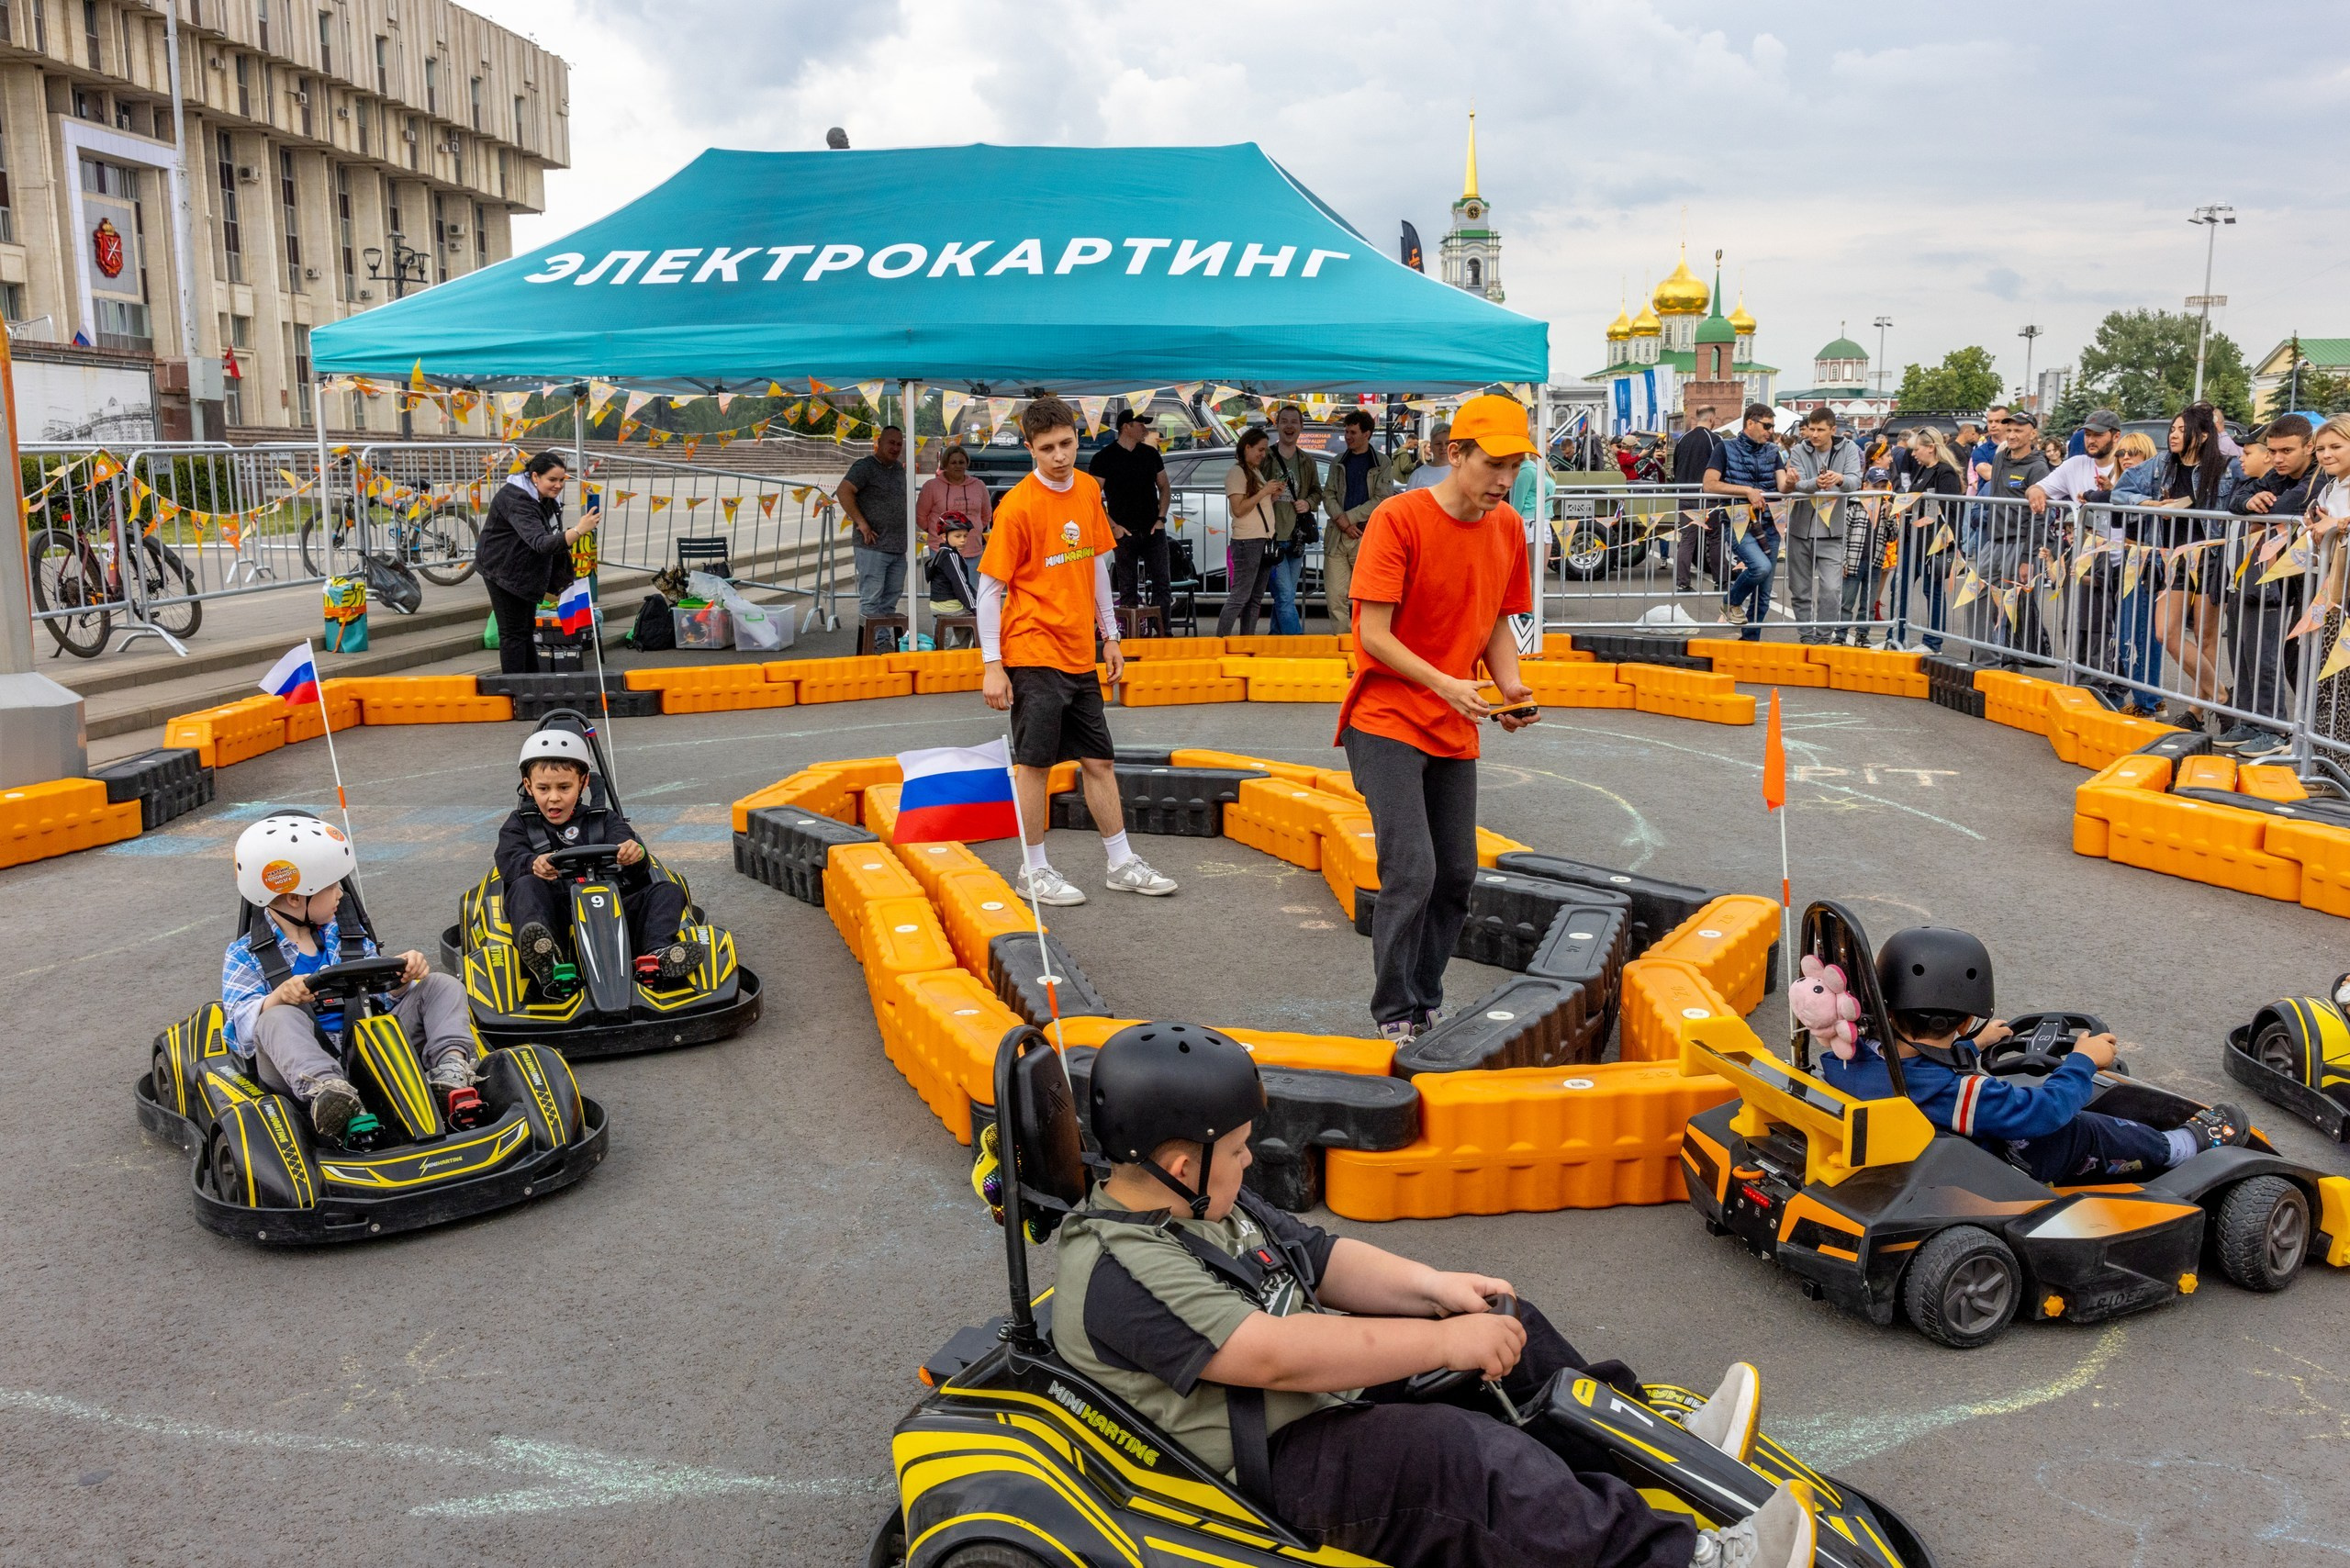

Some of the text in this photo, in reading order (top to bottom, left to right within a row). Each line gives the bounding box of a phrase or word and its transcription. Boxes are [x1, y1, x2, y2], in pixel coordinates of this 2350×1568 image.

[524, 238, 1350, 285] ЭЛЕКТРОКАРТИНГ
[264, 869, 298, 883] ГОЛОВНОГО
[590, 895, 605, 908] 9
[1047, 1380, 1160, 1467] MINIKARTING
[1610, 1397, 1654, 1428] 7
